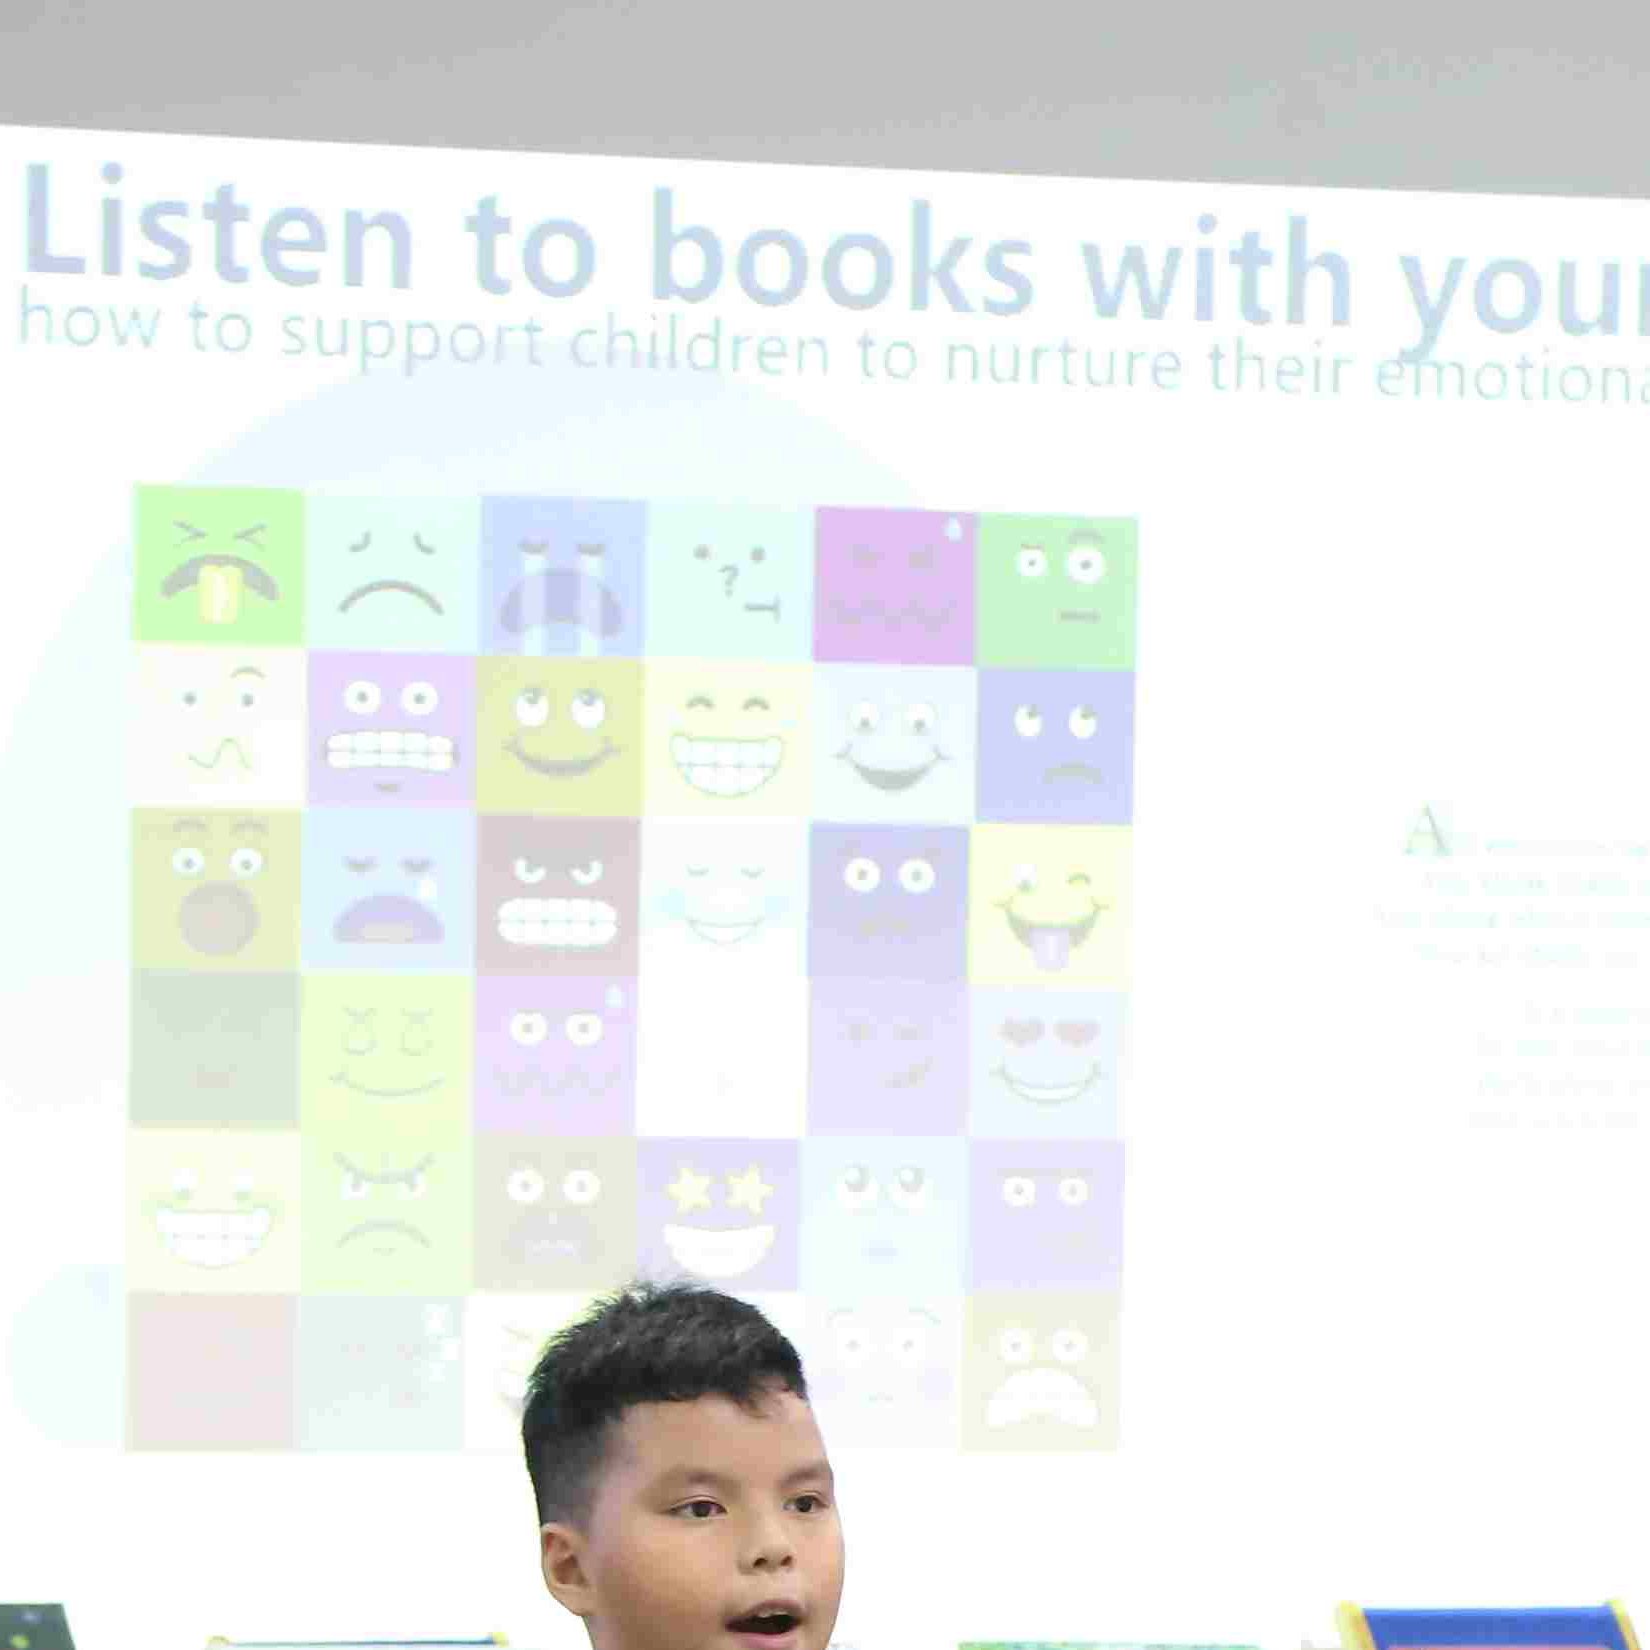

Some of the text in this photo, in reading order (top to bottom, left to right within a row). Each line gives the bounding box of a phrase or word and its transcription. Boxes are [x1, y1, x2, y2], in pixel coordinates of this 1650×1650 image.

[25, 160, 413, 290] Listen
[463, 194, 596, 299] to
[651, 187, 1035, 318] books
[1080, 212, 1351, 327] with
[18, 285, 160, 350] how
[187, 298, 252, 355] to
[280, 310, 543, 377] support
[568, 312, 831, 379] children
[857, 328, 919, 382] to
[946, 337, 1183, 393] nurture
[1208, 334, 1353, 396] their
